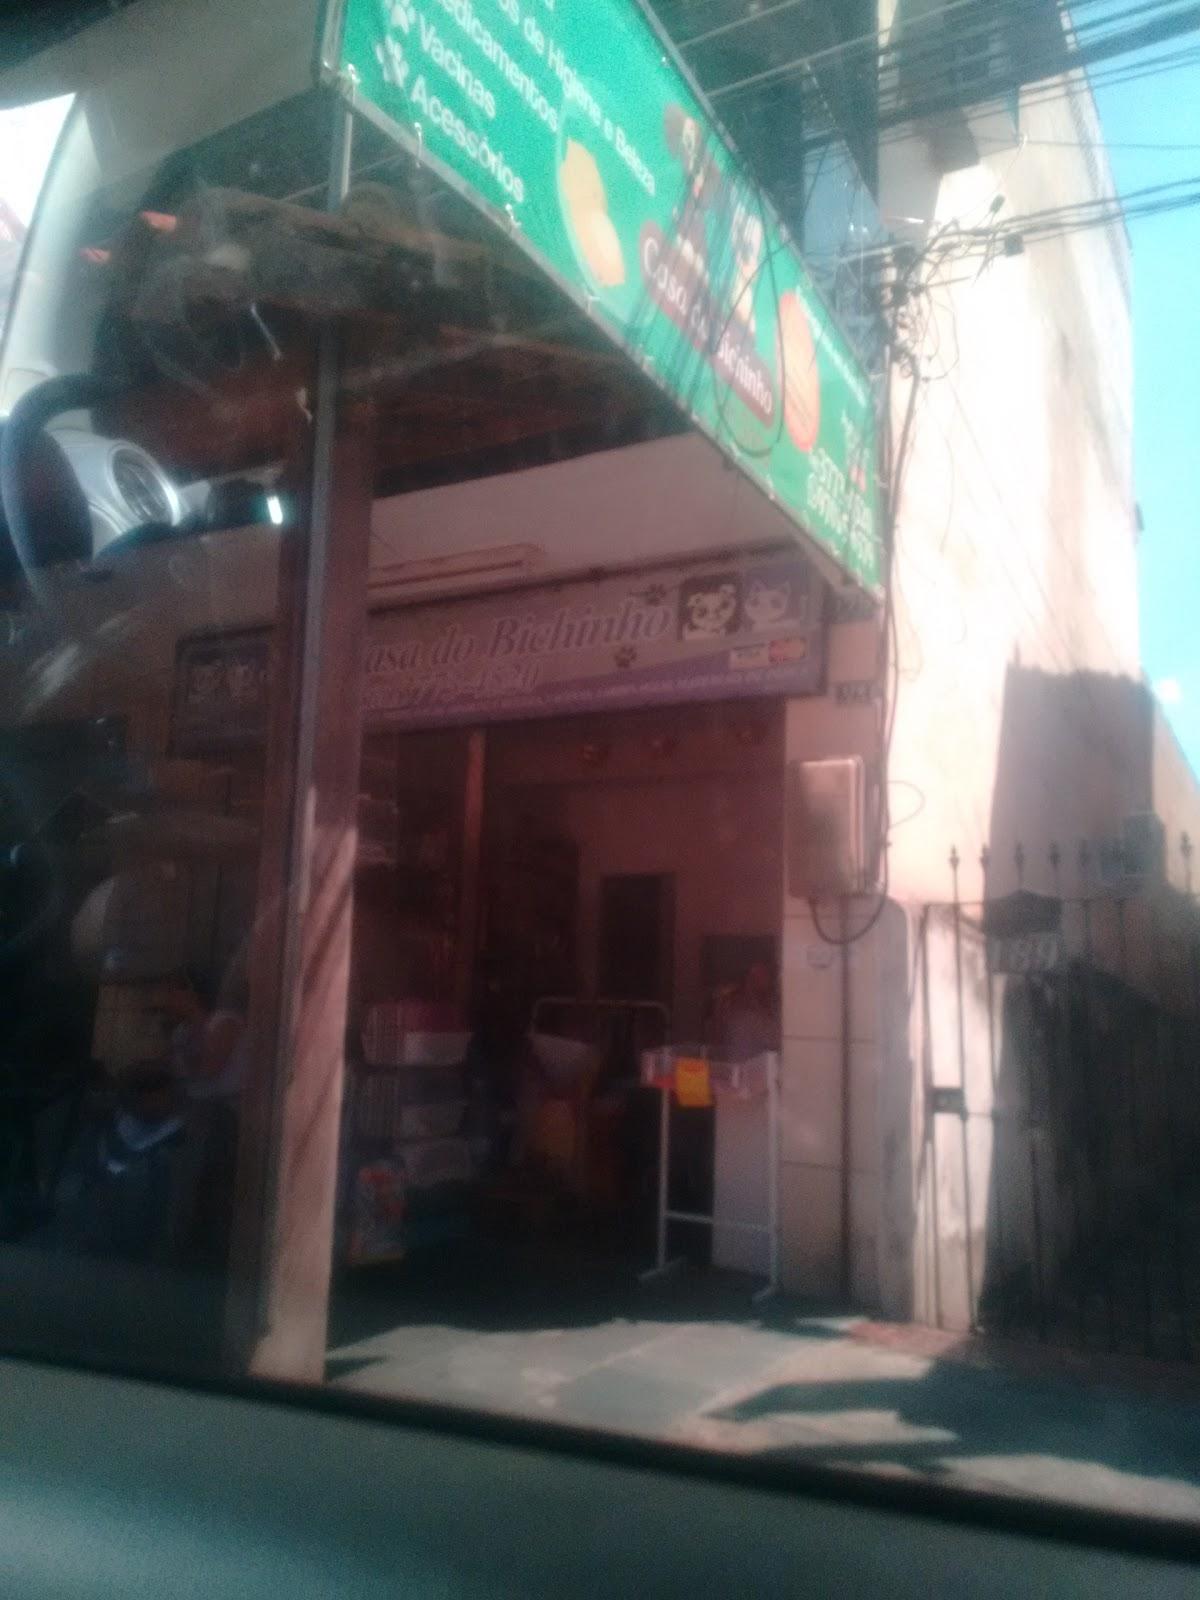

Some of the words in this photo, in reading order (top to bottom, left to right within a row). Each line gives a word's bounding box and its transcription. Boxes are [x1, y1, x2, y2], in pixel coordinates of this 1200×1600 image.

[420, 12, 497, 120] Vacinas
[438, 0, 560, 134] edicamentos
[523, 16, 546, 56] de
[602, 118, 615, 143] e
[410, 73, 525, 203] Acessórios
[644, 236, 688, 317] Casa
[365, 644, 422, 673] asa
[431, 626, 476, 667] do
[489, 598, 675, 659] Bichinho
